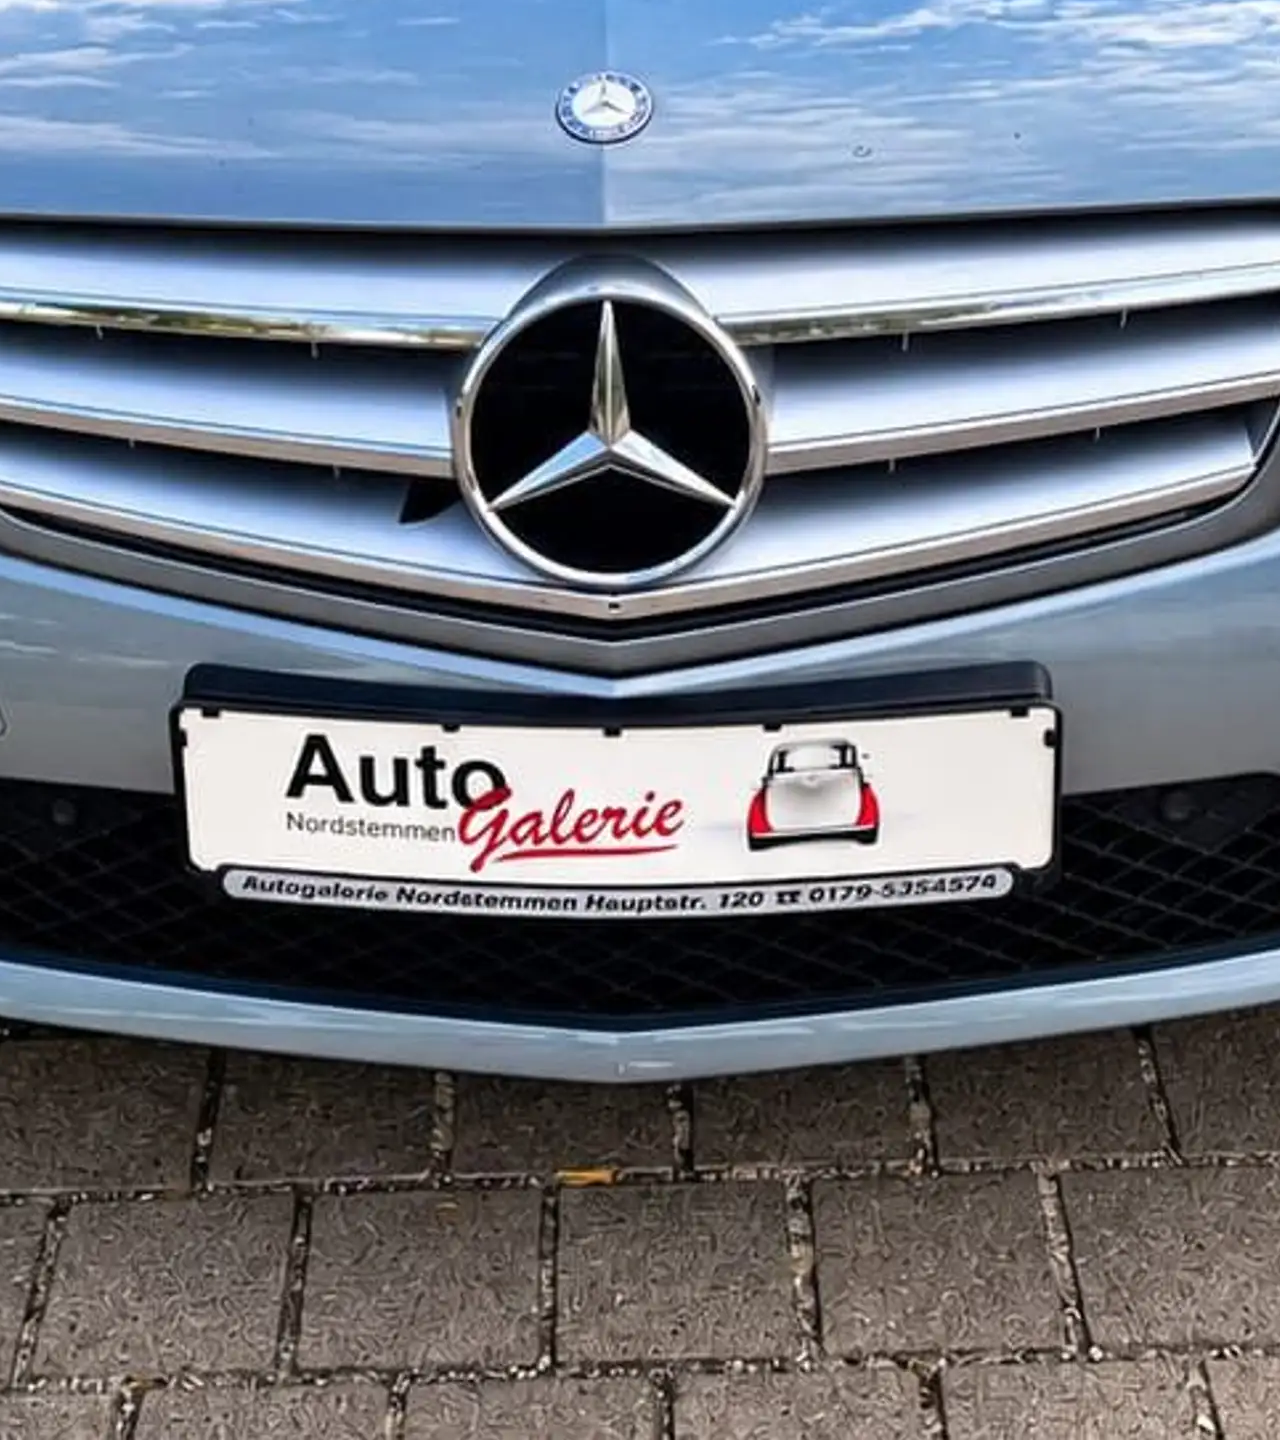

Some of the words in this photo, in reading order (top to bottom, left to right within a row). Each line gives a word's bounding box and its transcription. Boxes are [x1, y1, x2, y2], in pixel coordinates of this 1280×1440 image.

[286, 733, 507, 809] Auto
[286, 811, 456, 843] Nordstemmen
[458, 787, 685, 872] Galerie
[242, 874, 390, 904] Autogalerie
[395, 885, 578, 912] Nordstemmen
[584, 892, 708, 915] Hauptstr.
[719, 891, 764, 909] 120
[808, 873, 998, 904] 0179-5354574
